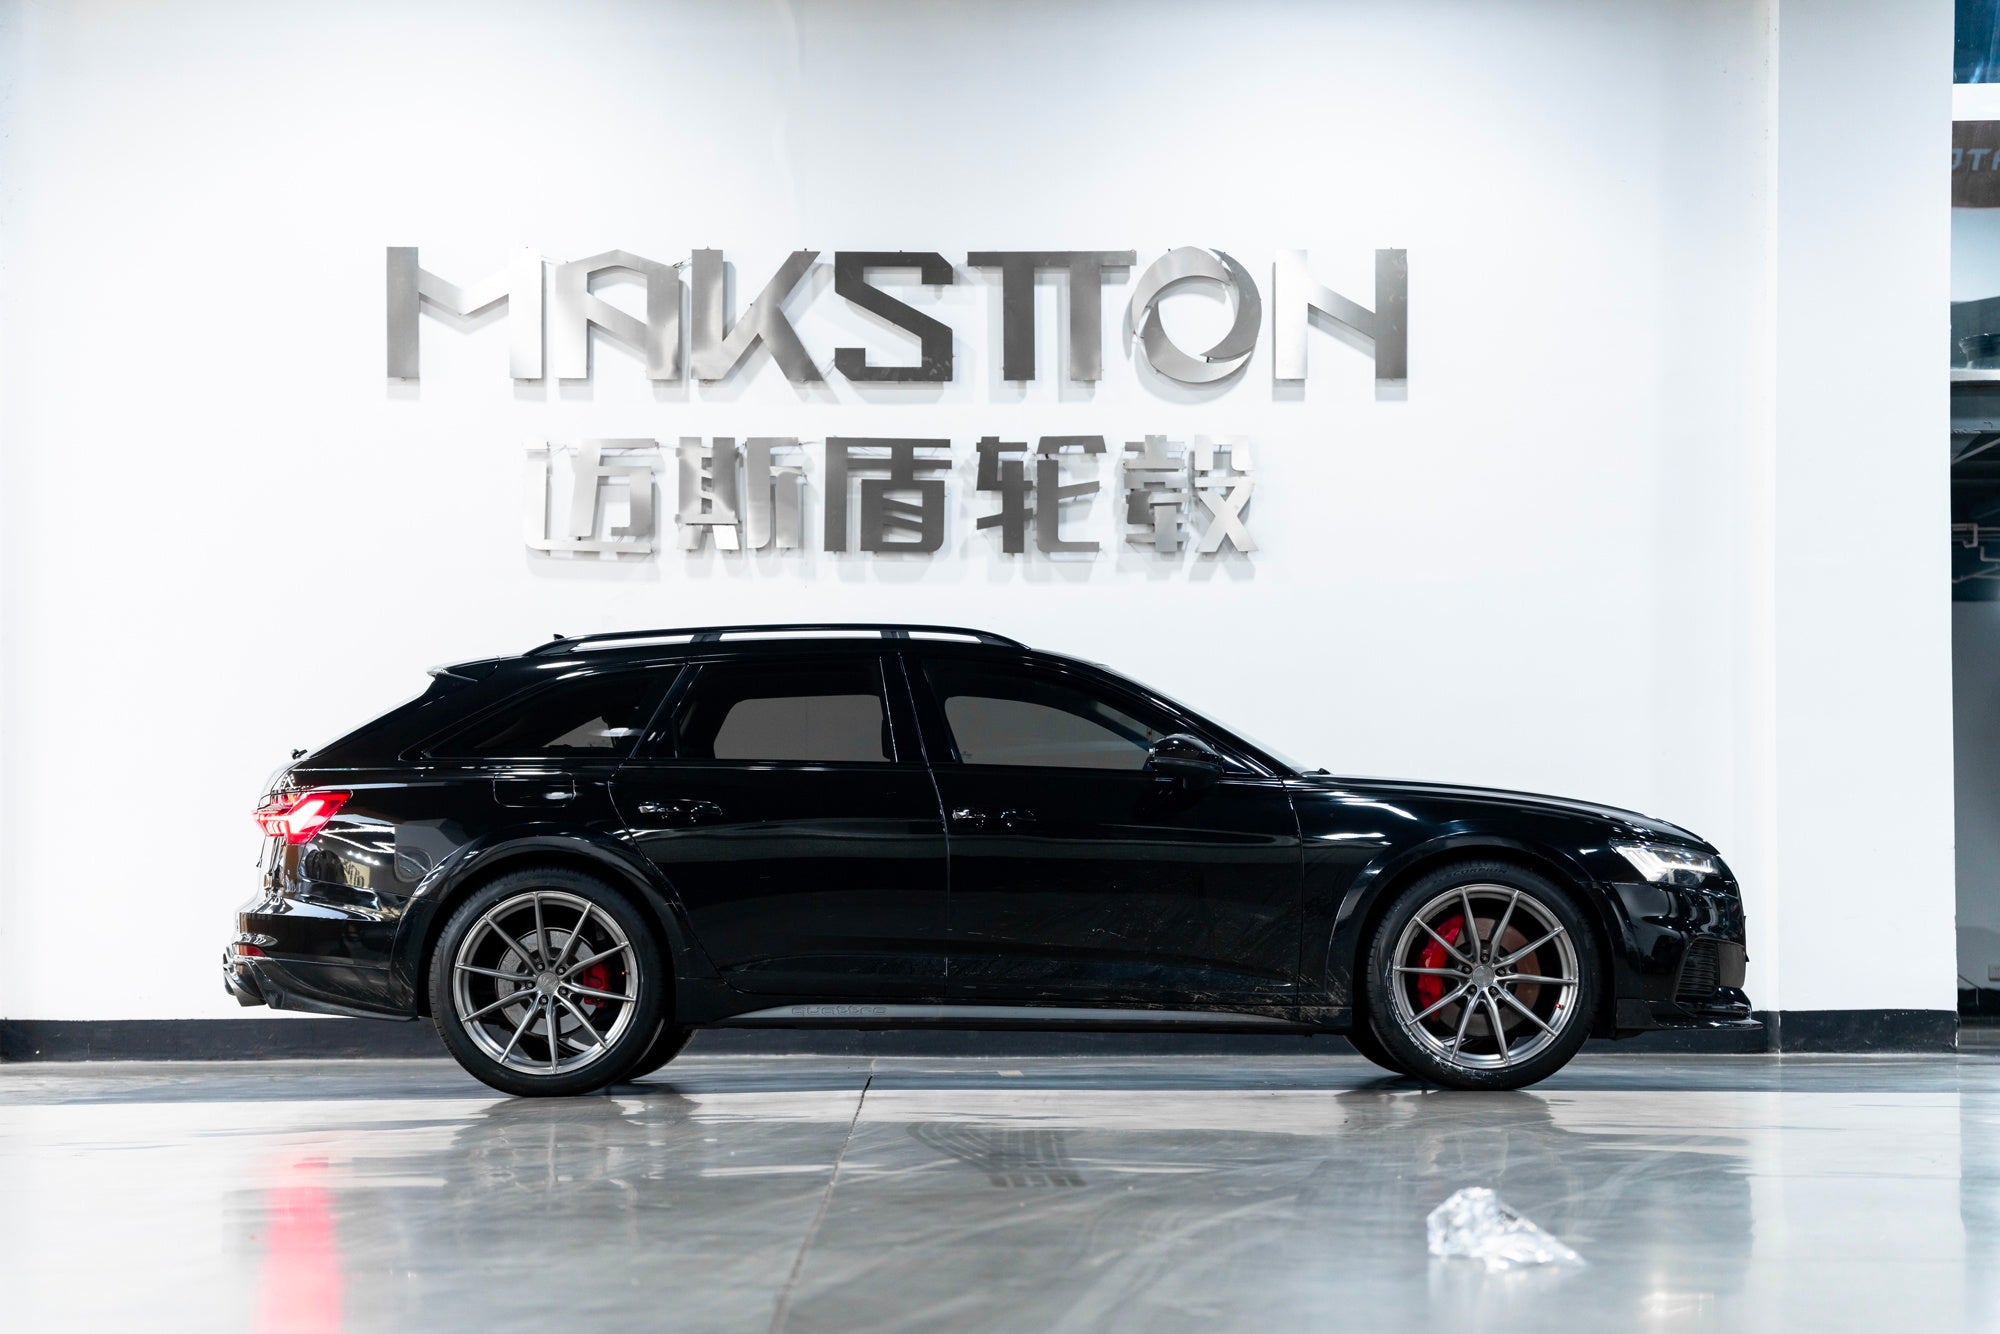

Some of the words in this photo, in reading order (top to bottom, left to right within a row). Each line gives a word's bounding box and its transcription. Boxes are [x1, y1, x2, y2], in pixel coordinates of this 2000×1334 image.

[523, 435, 1258, 553] 迈斯盾轮毂
[791, 1006, 889, 1016] quattro
